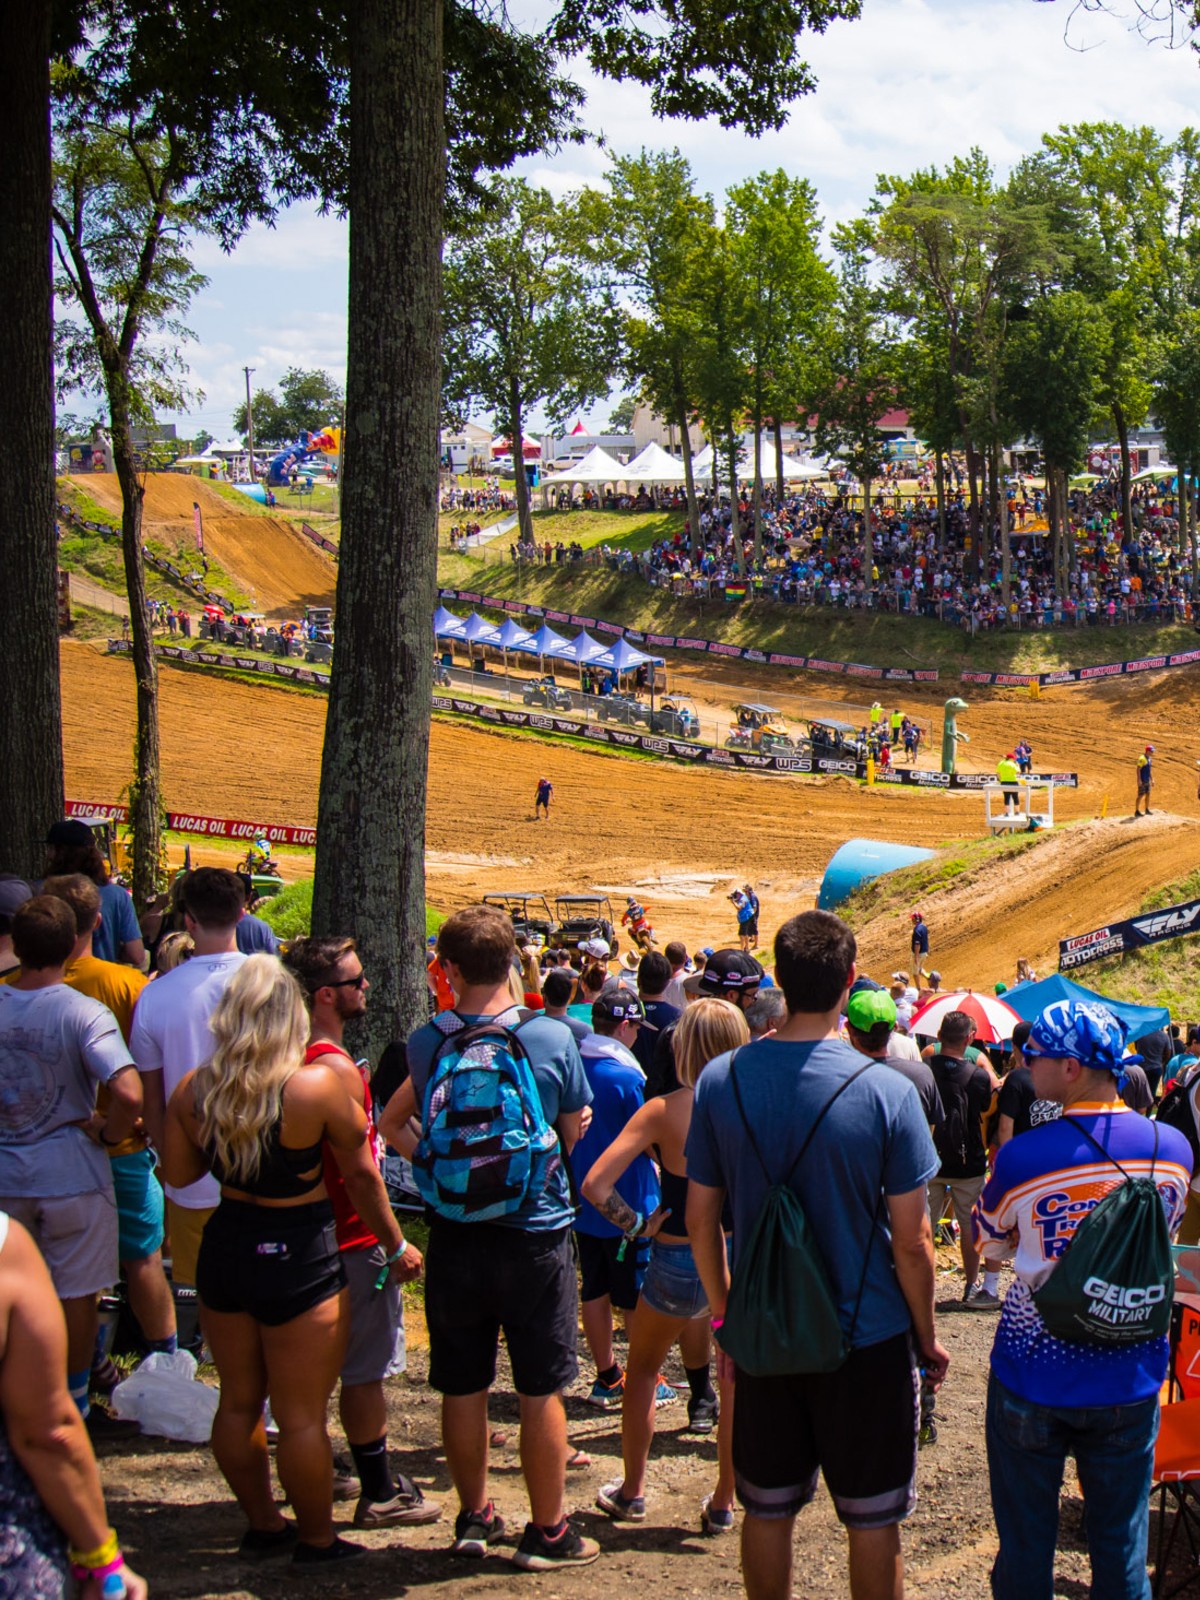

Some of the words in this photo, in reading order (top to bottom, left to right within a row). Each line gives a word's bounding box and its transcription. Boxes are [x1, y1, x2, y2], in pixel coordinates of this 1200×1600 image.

[642, 736, 670, 753] WPS
[776, 758, 812, 772] WPS
[818, 760, 857, 772] GEICO
[910, 771, 950, 782] GEICO
[956, 774, 998, 784] GEICO
[71, 804, 106, 817] LUCAS
[108, 807, 126, 821] OIL
[172, 816, 207, 832] LUCAS
[209, 820, 226, 835] OIL
[231, 824, 268, 840] LUCAS
[269, 828, 288, 842] OIL
[292, 830, 317, 845] LUC
[1148, 922, 1192, 938] RACING
[1070, 934, 1094, 950] LUCAS
[1095, 930, 1108, 940] OIL
[1083, 1276, 1166, 1309] GEICO
[1088, 1300, 1154, 1324] MILITARY
